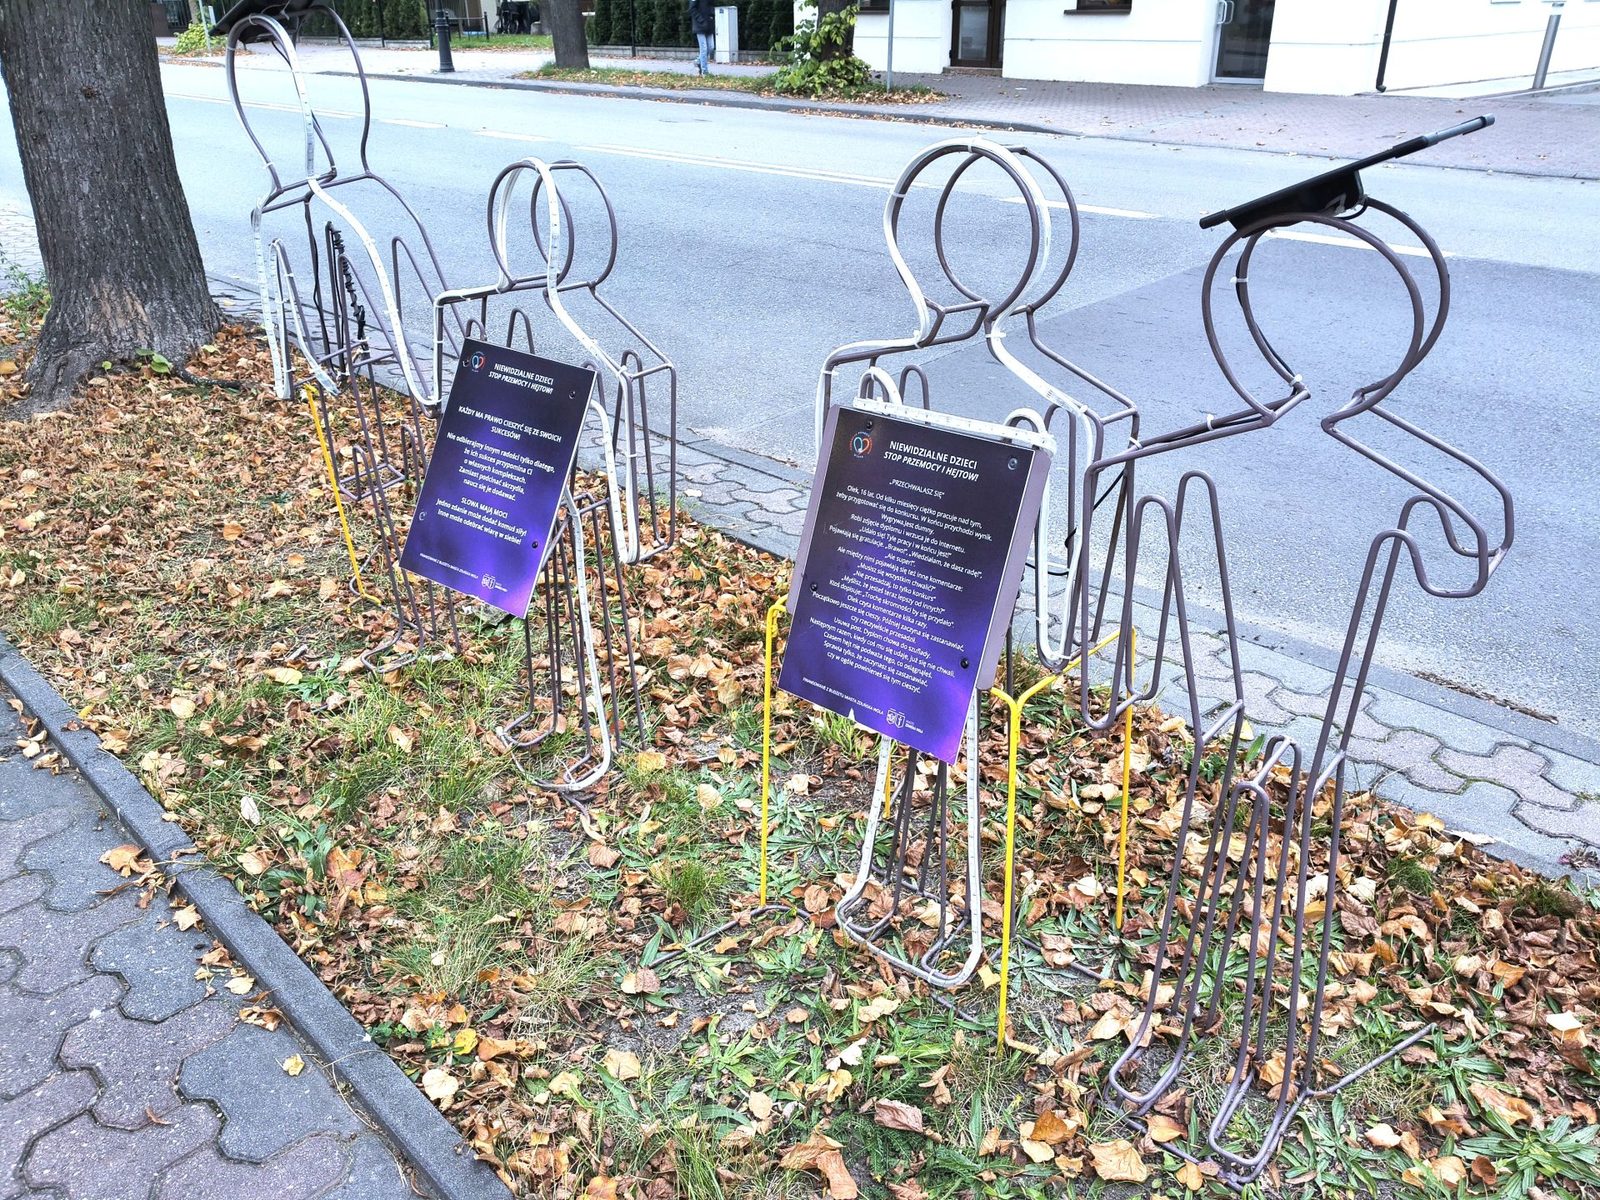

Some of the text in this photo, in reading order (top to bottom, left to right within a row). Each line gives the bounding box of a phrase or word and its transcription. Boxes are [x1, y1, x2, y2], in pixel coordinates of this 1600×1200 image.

[494, 363, 554, 385] NIEWIDZIALNE DZIECI
[501, 375, 529, 387] PRZEMOCY
[883, 451, 902, 461] STOP
[902, 456, 942, 472] PRZEMOCY
[889, 441, 949, 462] NIEWIDZIALNE
[949, 455, 977, 469] DZIECI
